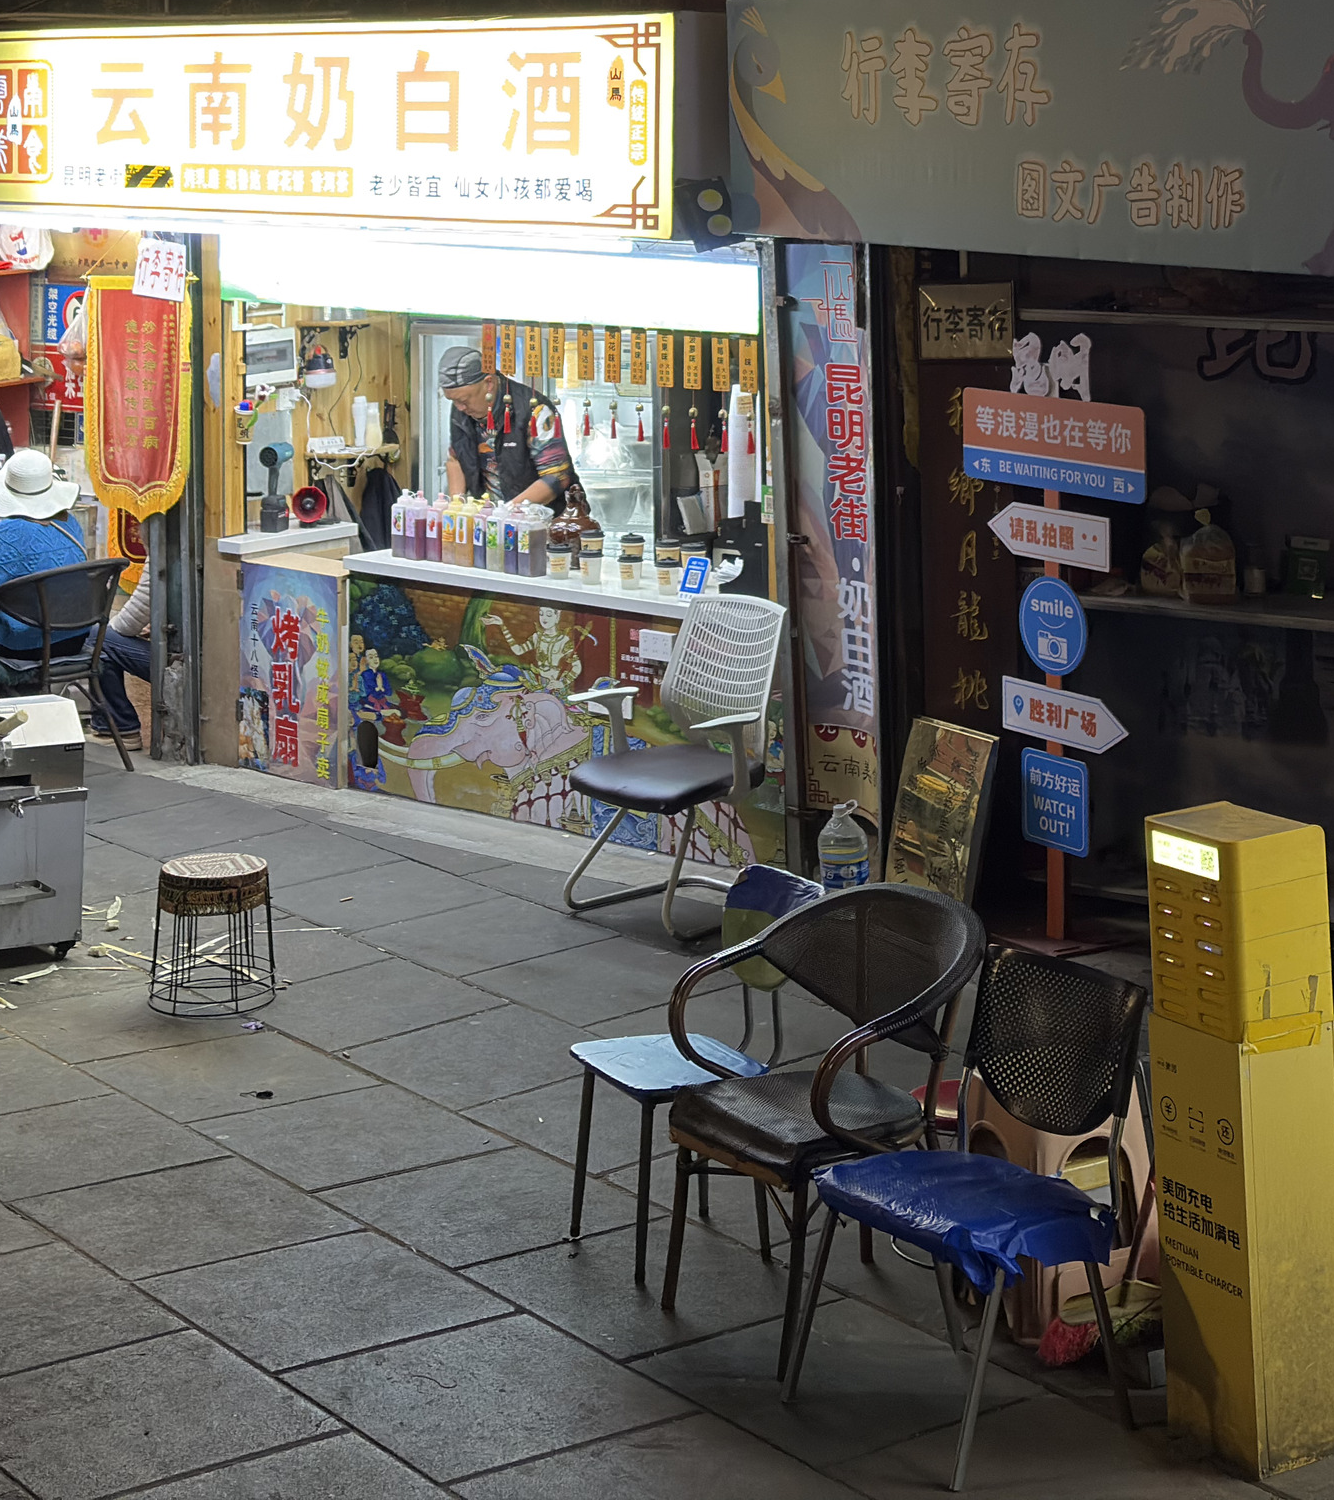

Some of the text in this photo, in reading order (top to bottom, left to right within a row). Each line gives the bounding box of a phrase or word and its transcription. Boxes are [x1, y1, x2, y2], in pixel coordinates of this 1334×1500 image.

[841, 22, 1052, 127] 行李寄存
[91, 51, 582, 156] 云南奶白酒
[368, 174, 595, 203] 老少皆宜 仙女小孩都爱喝
[1015, 159, 1247, 231] 图文广告制作
[922, 305, 1010, 342] 行李寄存
[974, 404, 1132, 454] 等浪漫也在等你
[980, 457, 1125, 494] 东 BE WAITING FOR YOU 西
[1008, 514, 1075, 551] 请乱拍照
[1030, 597, 1075, 620] smile
[270, 606, 300, 768] 烤乳扇
[314, 606, 330, 780] 牛奶做成扇子卖
[1028, 696, 1099, 739] 胜利广场
[1029, 767, 1081, 798] 前方好运
[1033, 793, 1076, 820] WATCH
[1039, 817, 1070, 837] OUT!
[1161, 1175, 1213, 1216] 美团充电
[1162, 1200, 1242, 1252] 给生活加满电
[1164, 1235, 1200, 1262] MEITUAN
[1164, 1254, 1244, 1300] PORTABLE CHARGER
